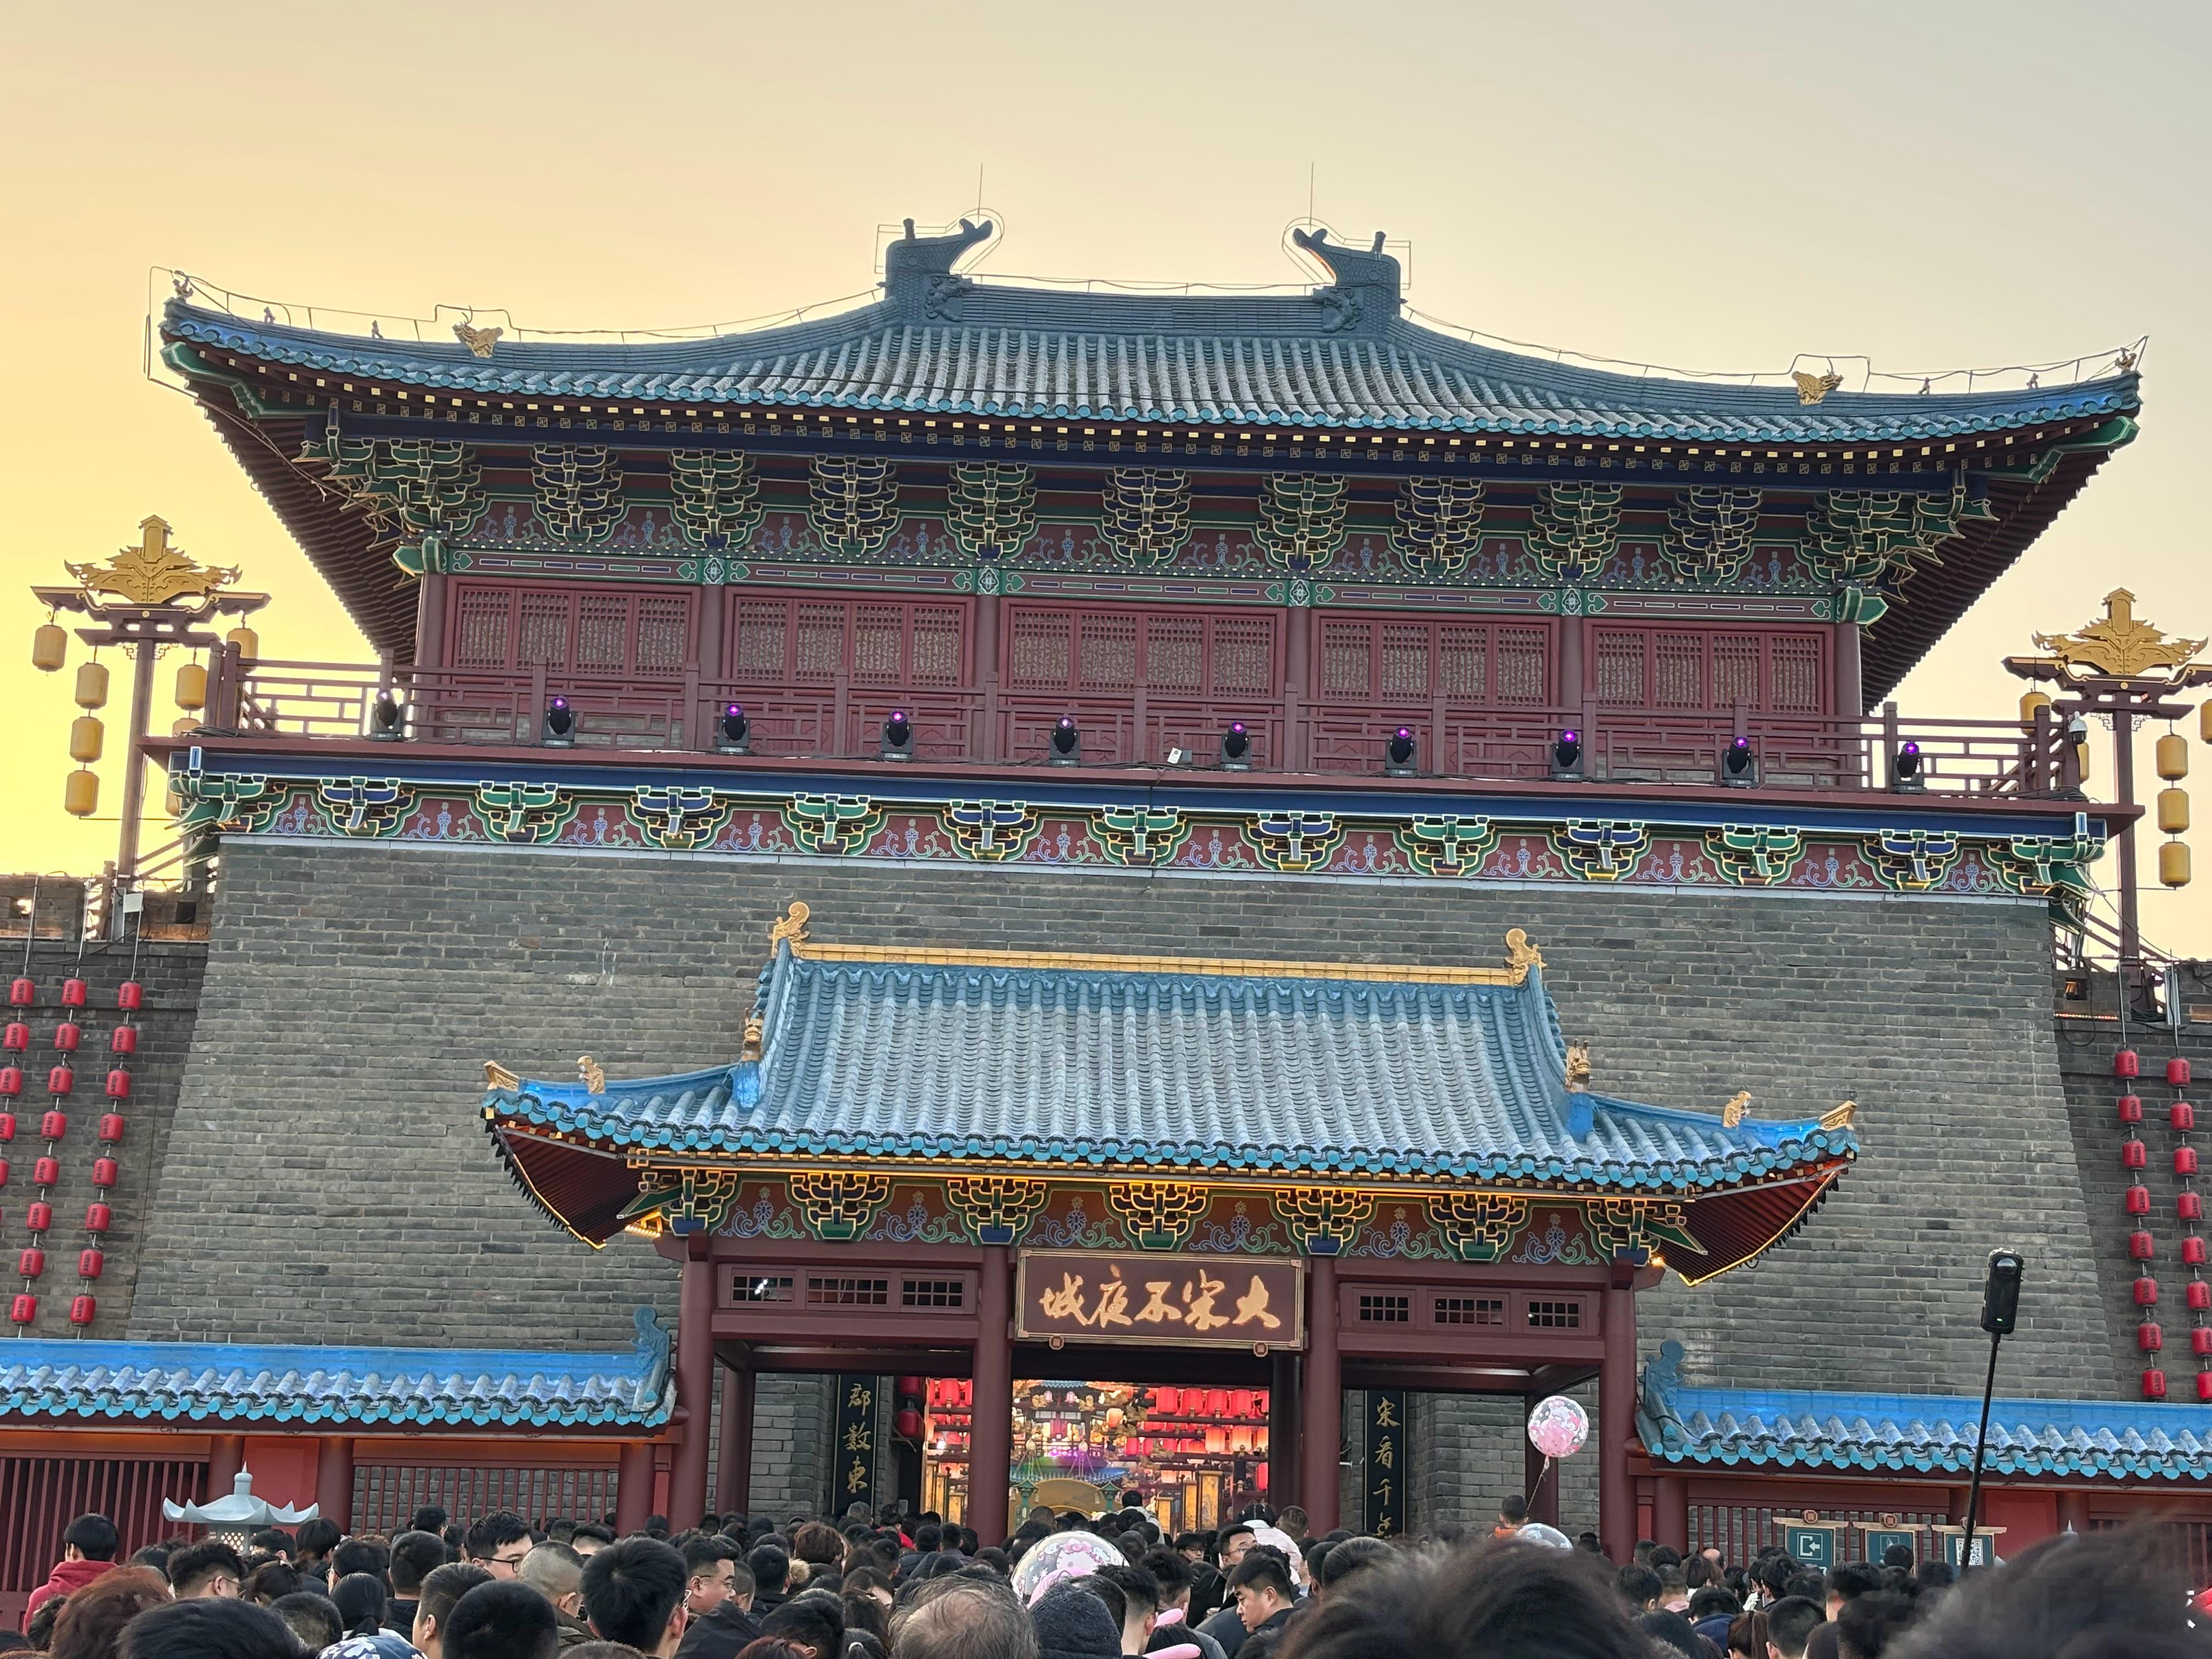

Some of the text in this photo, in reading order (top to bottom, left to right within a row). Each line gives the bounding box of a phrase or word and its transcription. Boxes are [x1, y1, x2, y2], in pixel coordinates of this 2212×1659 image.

[1038, 1263, 1282, 1330] 大宋不夜城
